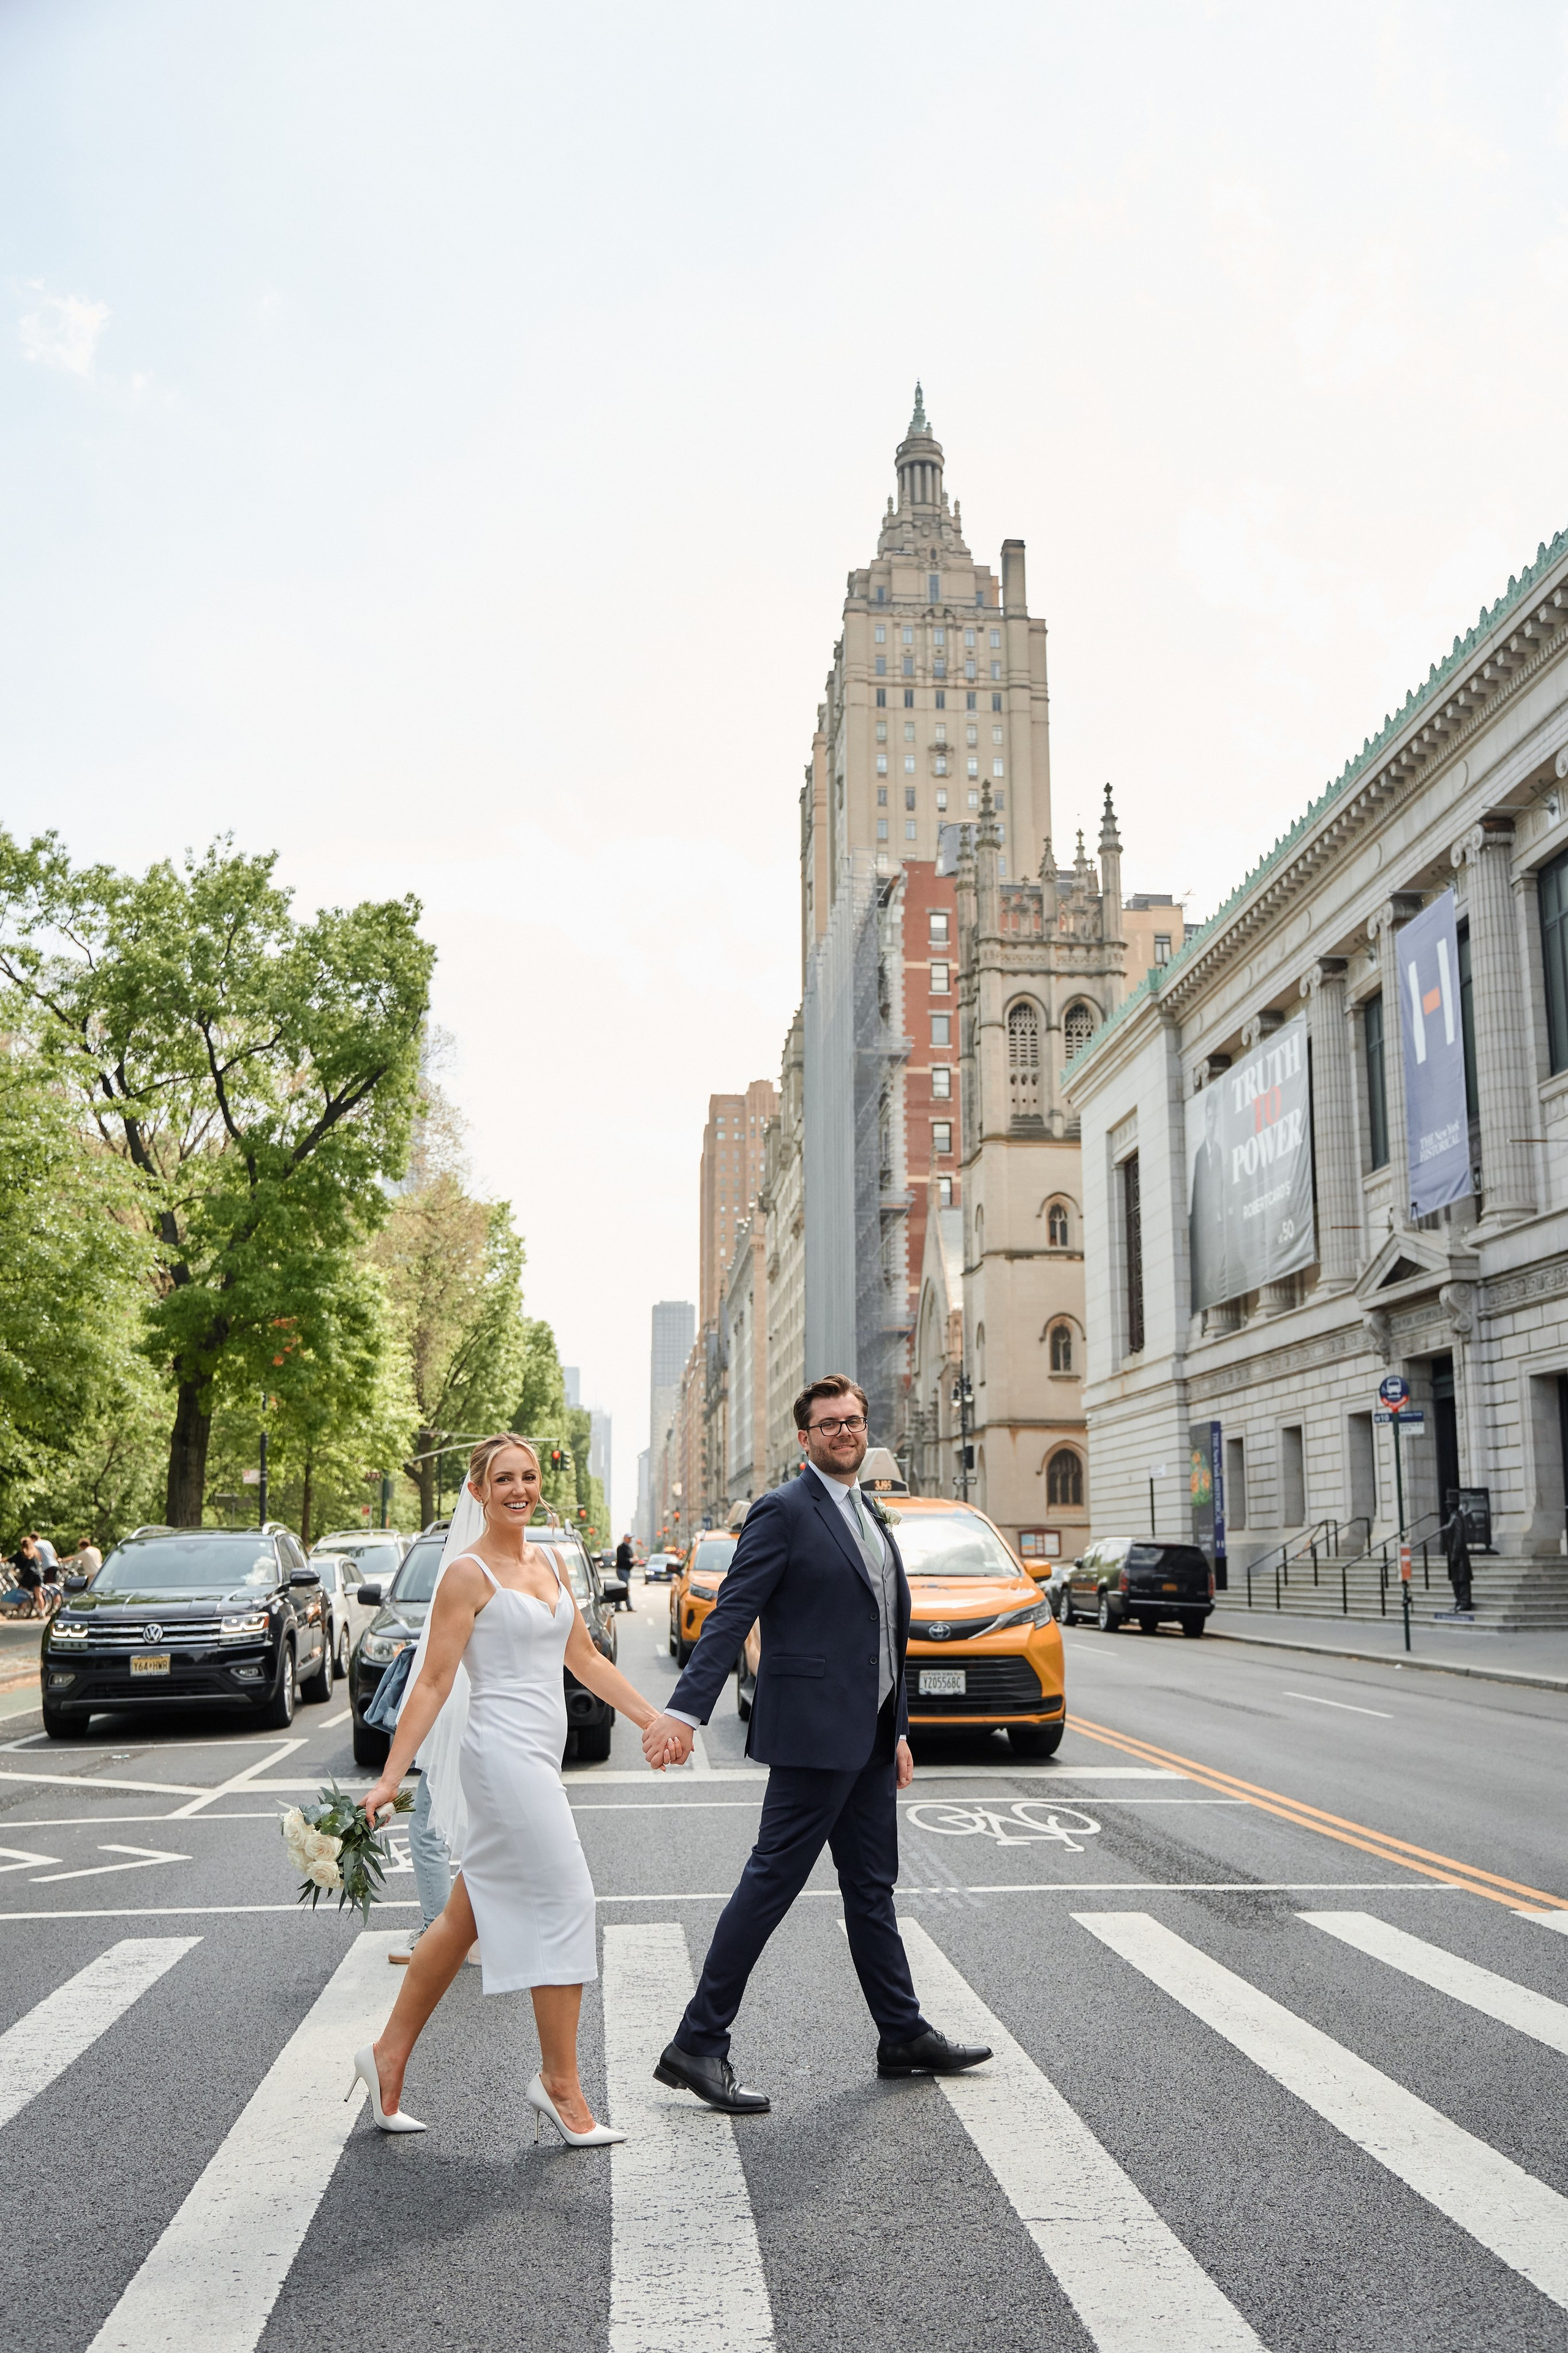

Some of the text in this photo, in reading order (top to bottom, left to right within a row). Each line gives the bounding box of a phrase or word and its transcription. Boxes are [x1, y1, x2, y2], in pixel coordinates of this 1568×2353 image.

[1231, 1031, 1301, 1114] TRUTH
[1251, 1085, 1282, 1136] TO
[1232, 1108, 1303, 1184] POWER
[1282, 1219, 1294, 1241] 50
[875, 1479, 892, 1490] 3J95
[923, 1677, 961, 1688] Y205568C
